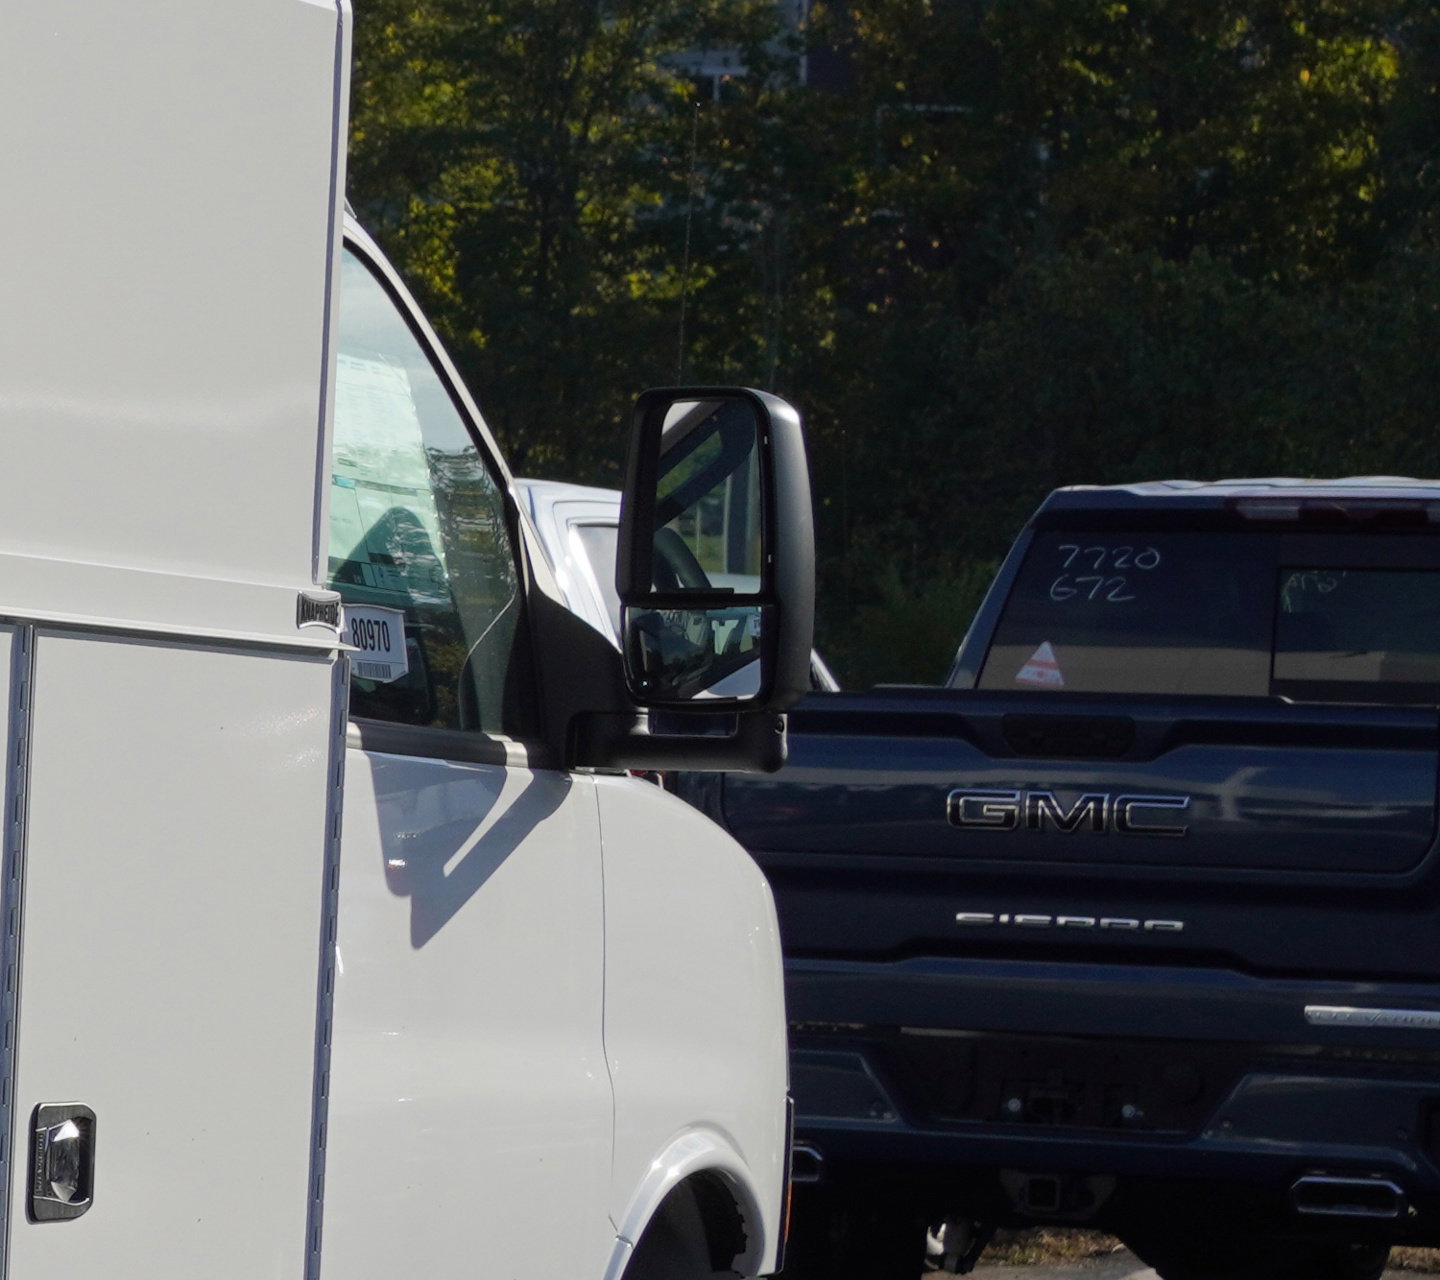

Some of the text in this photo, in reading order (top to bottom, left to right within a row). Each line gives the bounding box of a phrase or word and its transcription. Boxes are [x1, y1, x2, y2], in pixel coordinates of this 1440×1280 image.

[1058, 545, 1160, 570] 7720
[1049, 574, 1136, 602] 672
[301, 600, 339, 627] KNAPHEIDE
[351, 618, 390, 652] 80970
[947, 789, 1190, 837] GMC
[956, 912, 1185, 933] SIERRA
